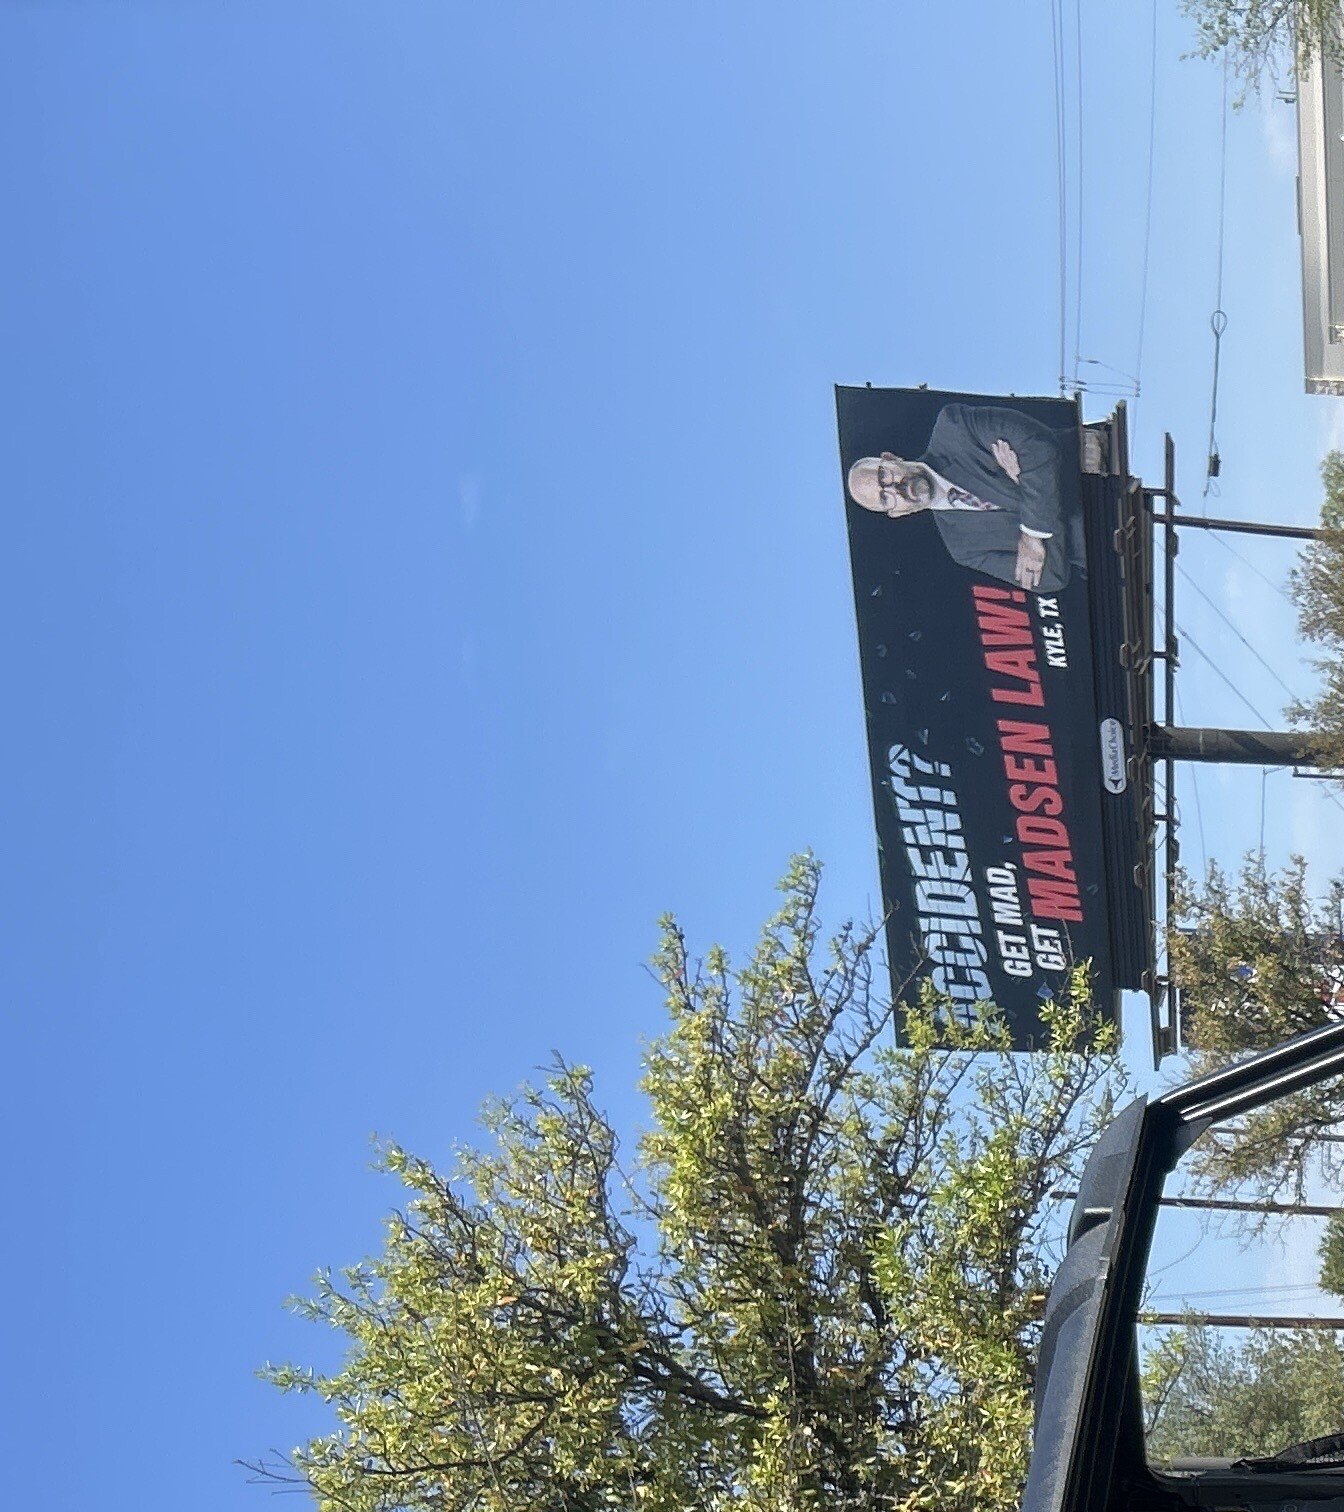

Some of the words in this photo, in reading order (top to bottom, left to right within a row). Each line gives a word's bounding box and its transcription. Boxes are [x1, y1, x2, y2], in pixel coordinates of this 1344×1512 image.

[1037, 596, 1060, 618] TX
[971, 584, 1046, 707] LAW!
[1041, 623, 1068, 668] KYLE,
[997, 720, 1084, 922] MADSEN
[985, 862, 1024, 926] MAD,
[997, 930, 1034, 977] GET
[1030, 923, 1067, 970] GET
